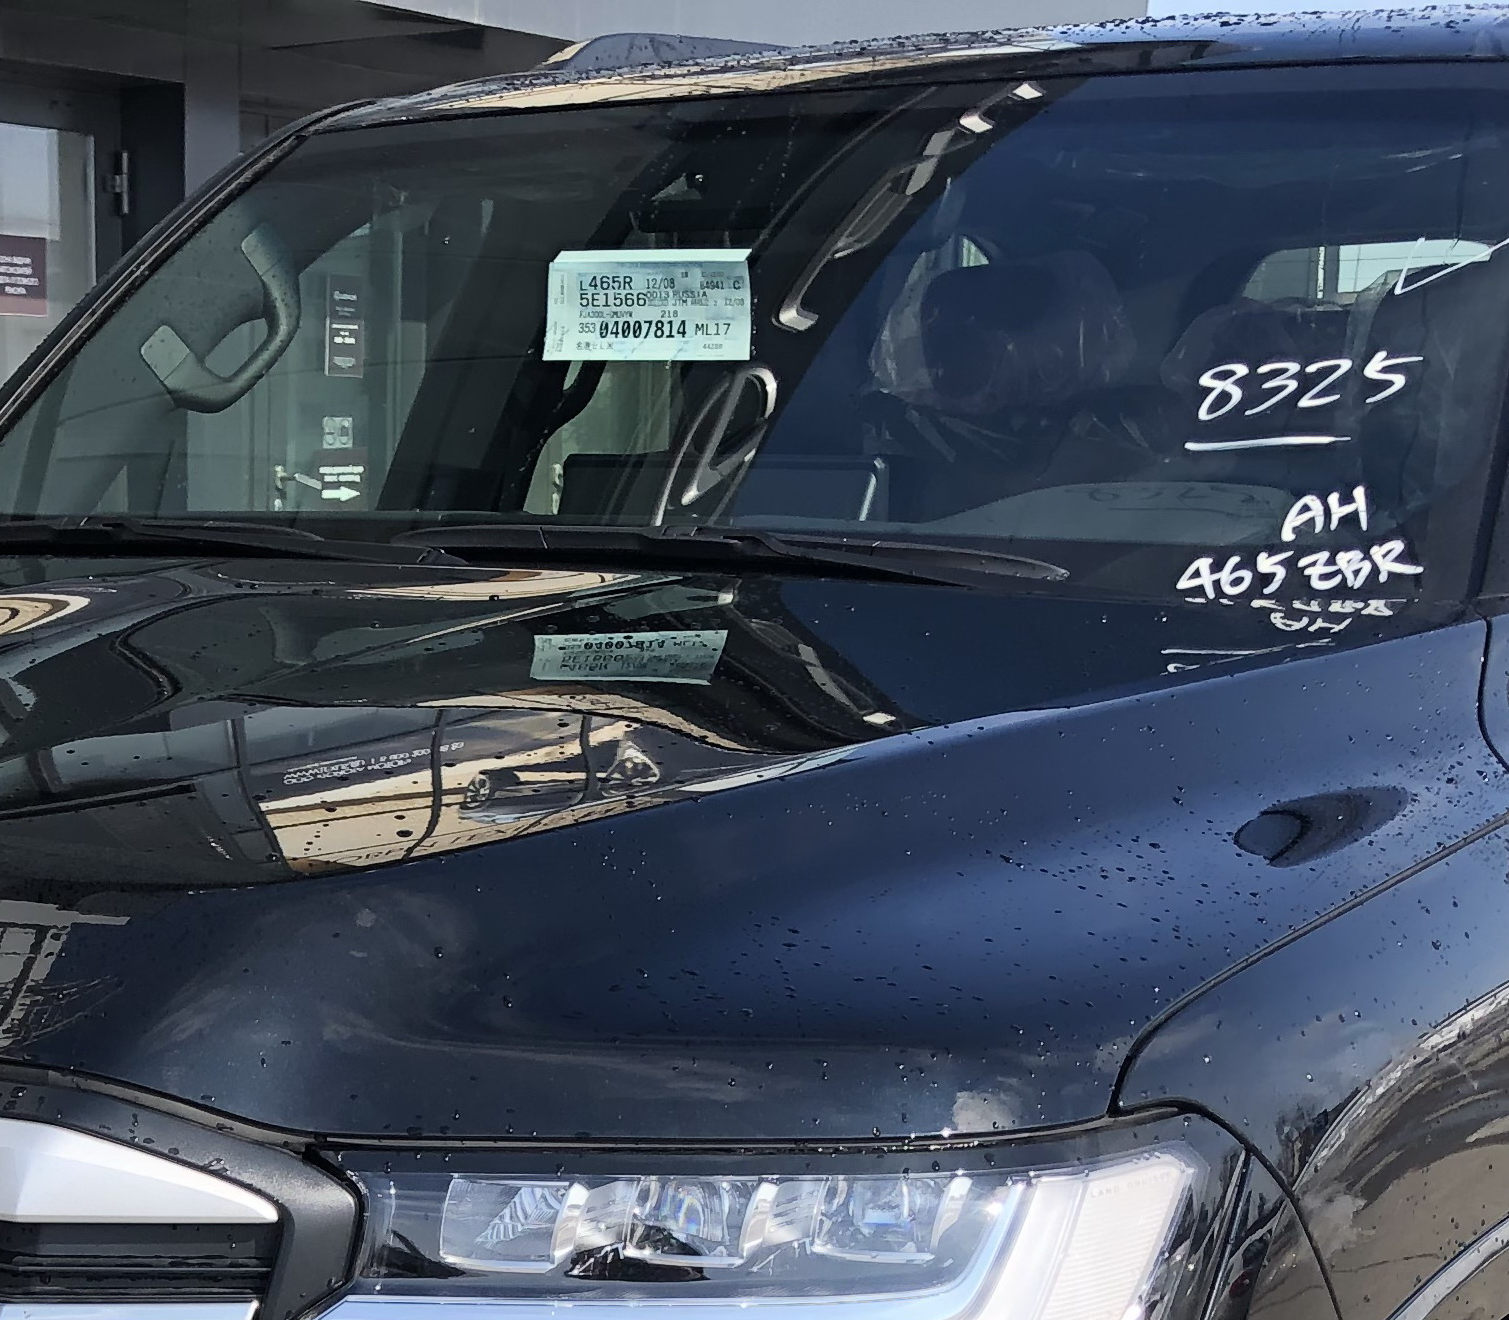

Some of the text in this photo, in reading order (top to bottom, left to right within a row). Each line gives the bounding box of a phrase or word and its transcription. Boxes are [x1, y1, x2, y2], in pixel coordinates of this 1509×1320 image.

[579, 275, 633, 291] L465R
[579, 292, 647, 308] 5E1566
[599, 320, 687, 339] 04007814
[694, 323, 731, 335] ML17
[1197, 349, 1424, 421] 8325
[1280, 484, 1369, 543] AH
